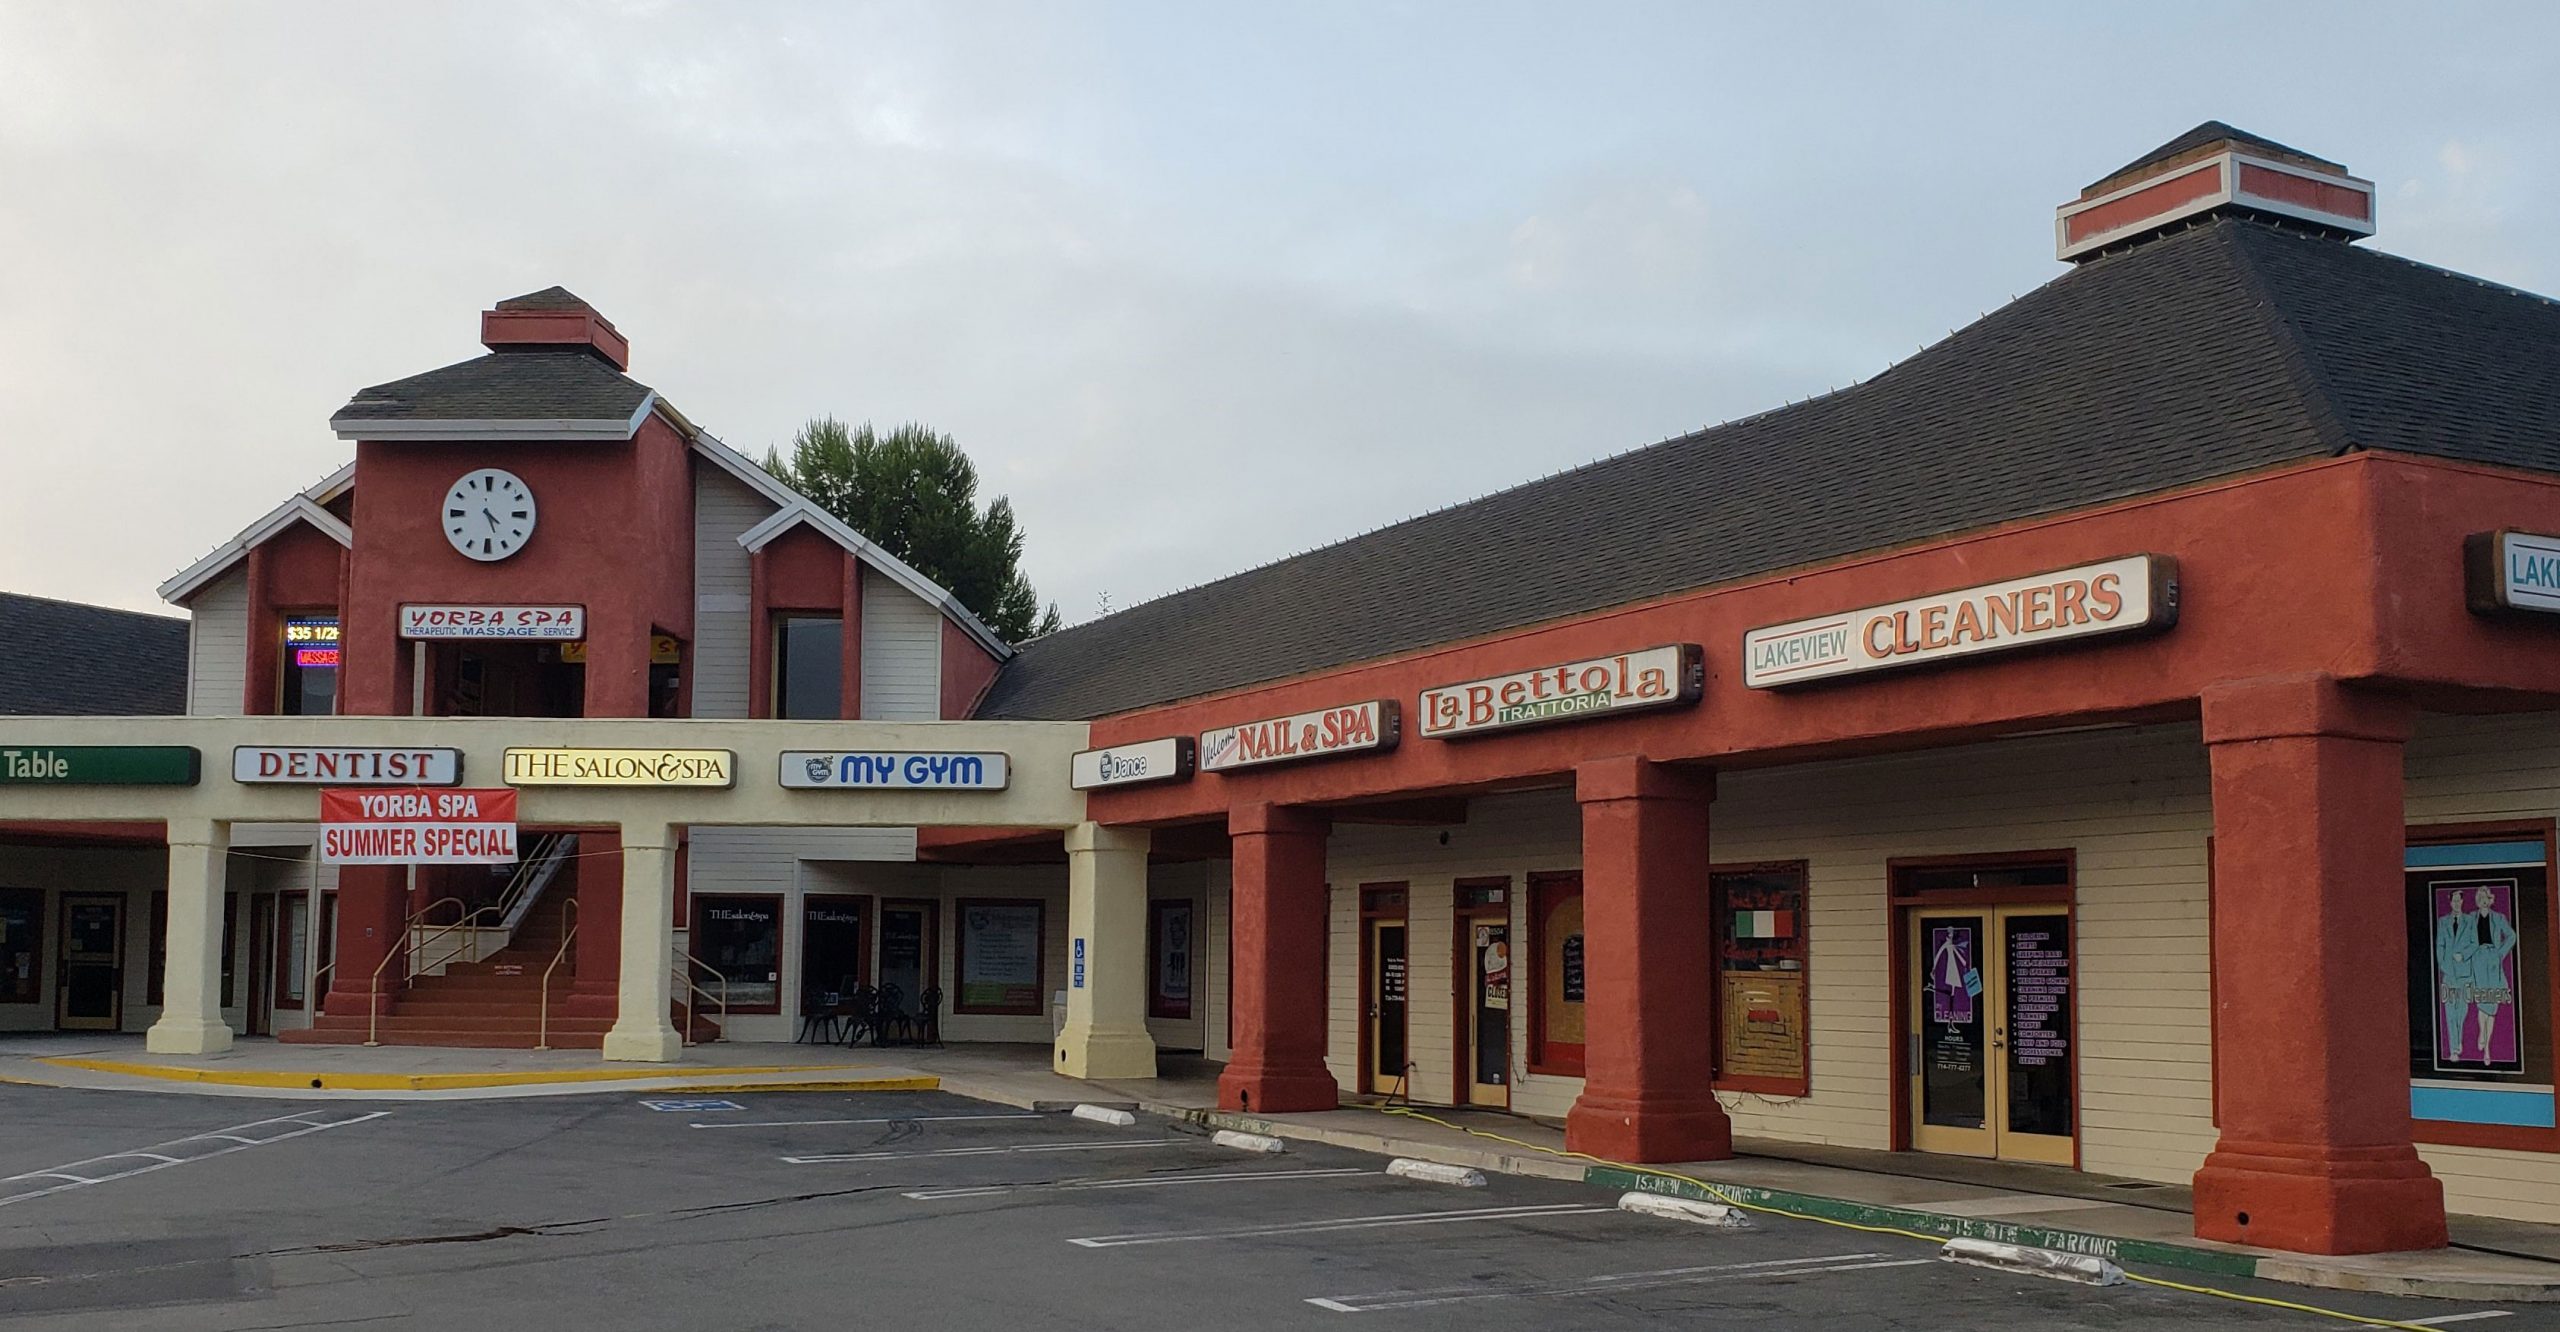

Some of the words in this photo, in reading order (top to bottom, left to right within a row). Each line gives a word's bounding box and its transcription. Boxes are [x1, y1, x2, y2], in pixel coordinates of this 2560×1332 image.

[411, 610, 505, 627] YORBA
[518, 610, 574, 627] SPA
[1753, 629, 1848, 671] LAKEVIEW
[1862, 573, 2123, 659] CLEANERS
[405, 627, 457, 636] THERAPEUTIC
[462, 627, 537, 637] MASSAGE
[543, 627, 576, 637] SERVICE
[1425, 692, 1463, 732] La
[1466, 655, 1671, 727] Bettola
[1500, 692, 1610, 723] TRATTORIA
[1238, 719, 1298, 762] NAIL
[1299, 723, 1318, 751] &
[1320, 705, 1375, 748] SPA
[3, 751, 69, 779] Table
[259, 753, 435, 779] DENTIST
[507, 753, 570, 778] THE
[840, 756, 890, 785] MY
[904, 755, 983, 786] GYM
[1113, 756, 1147, 779] Dance
[360, 795, 432, 818] YORBA
[438, 795, 479, 818] SPA
[326, 829, 420, 857] SUMMER
[423, 828, 513, 856] SPECIAL
[2464, 982, 2512, 1004] Cleaners
[2045, 1231, 2118, 1256] PARKING
